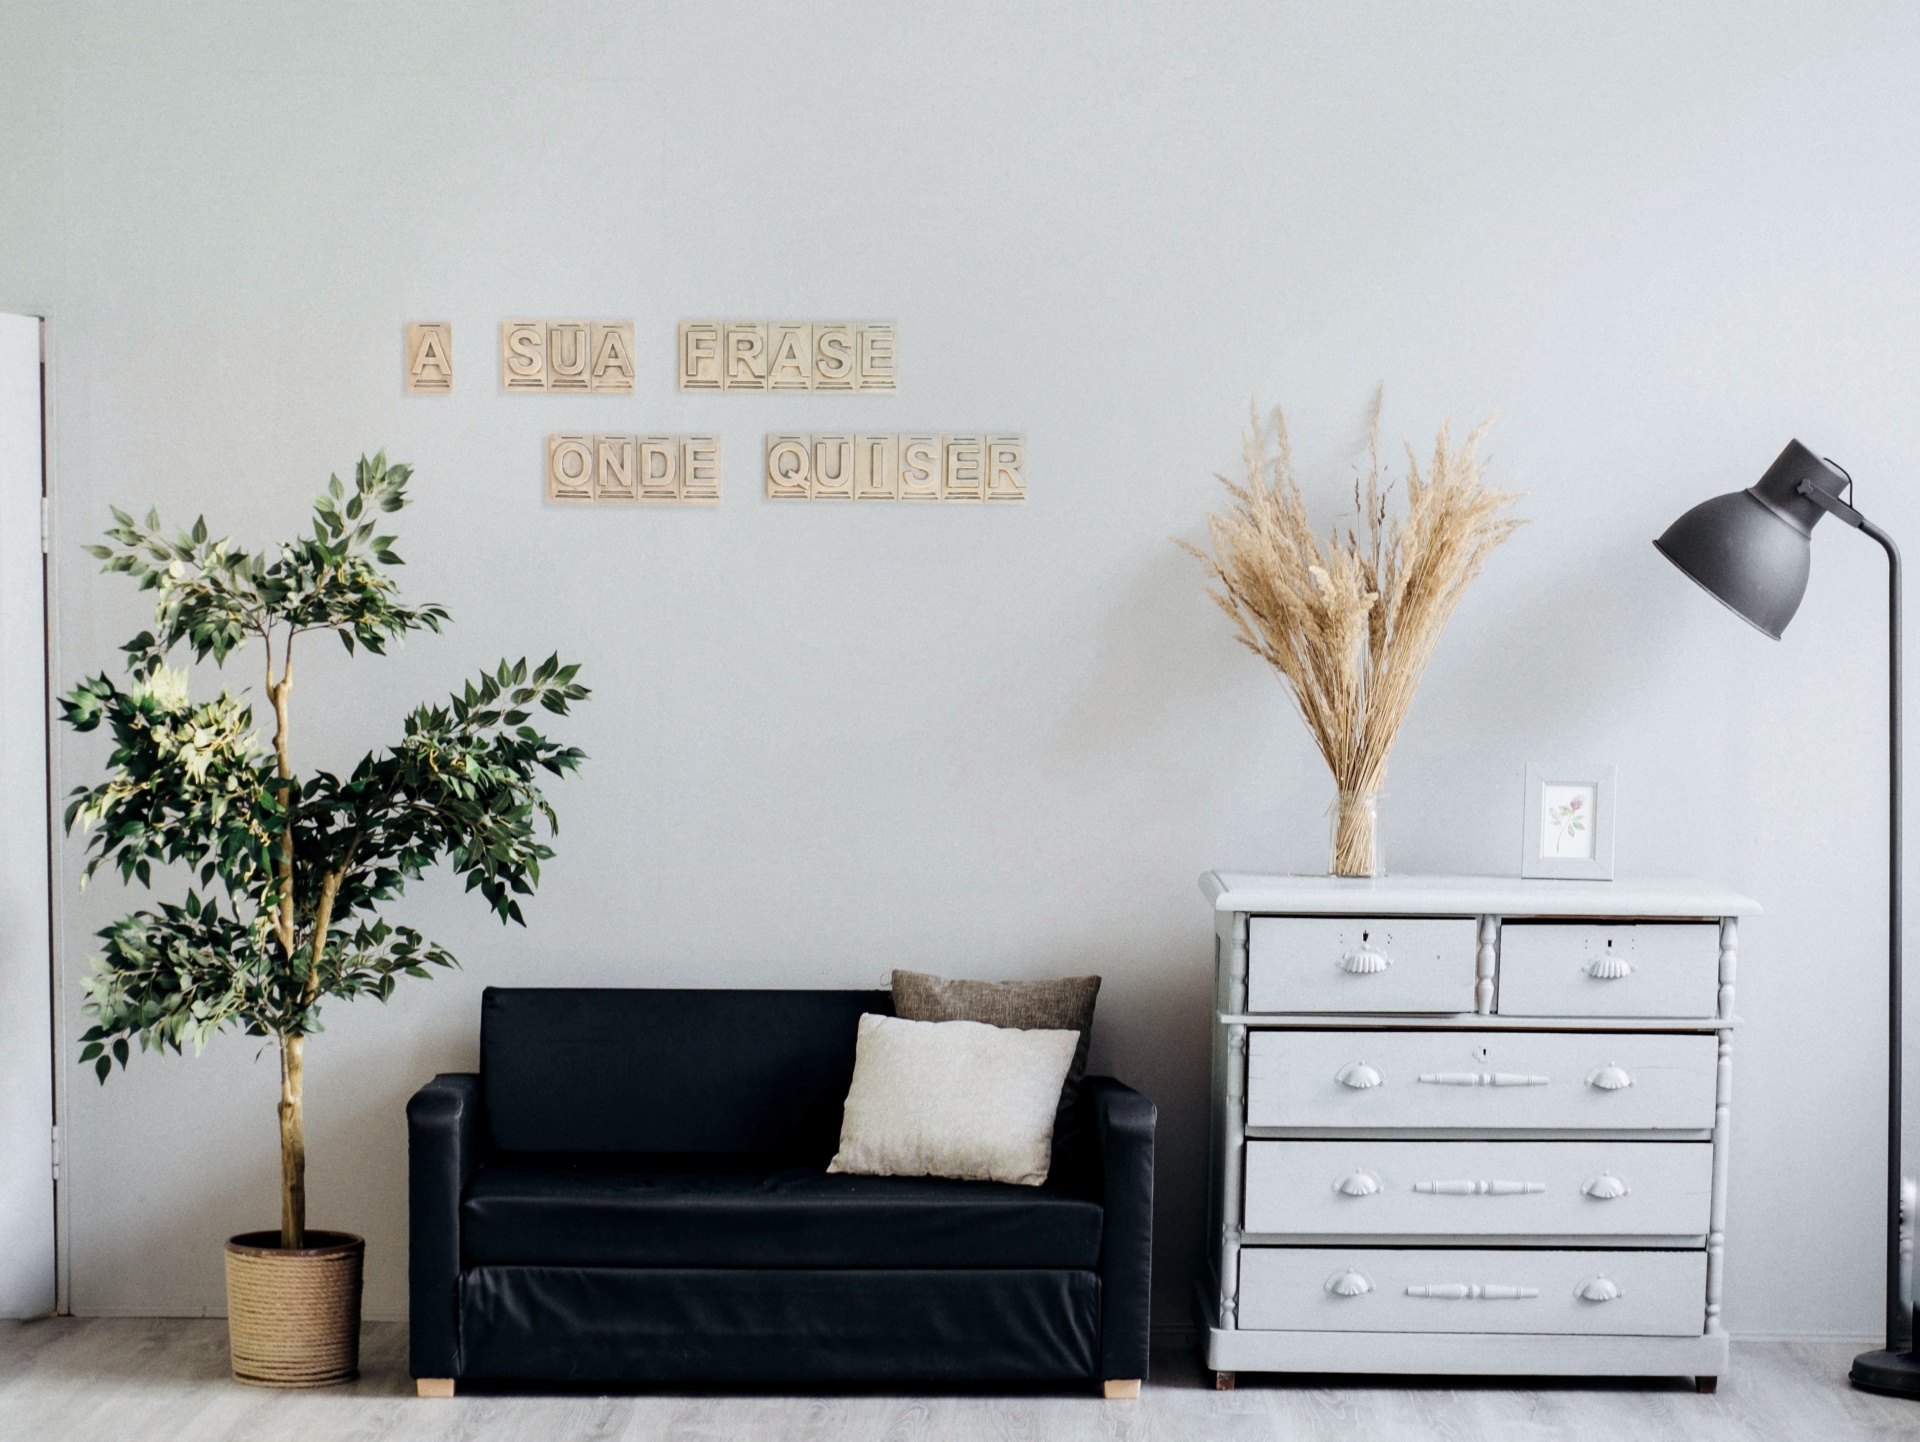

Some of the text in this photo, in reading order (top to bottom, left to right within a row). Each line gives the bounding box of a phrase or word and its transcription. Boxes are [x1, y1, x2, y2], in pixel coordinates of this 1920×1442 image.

[411, 330, 894, 378] A SUA FRASE
[552, 442, 1026, 490] ONDE QUISER
